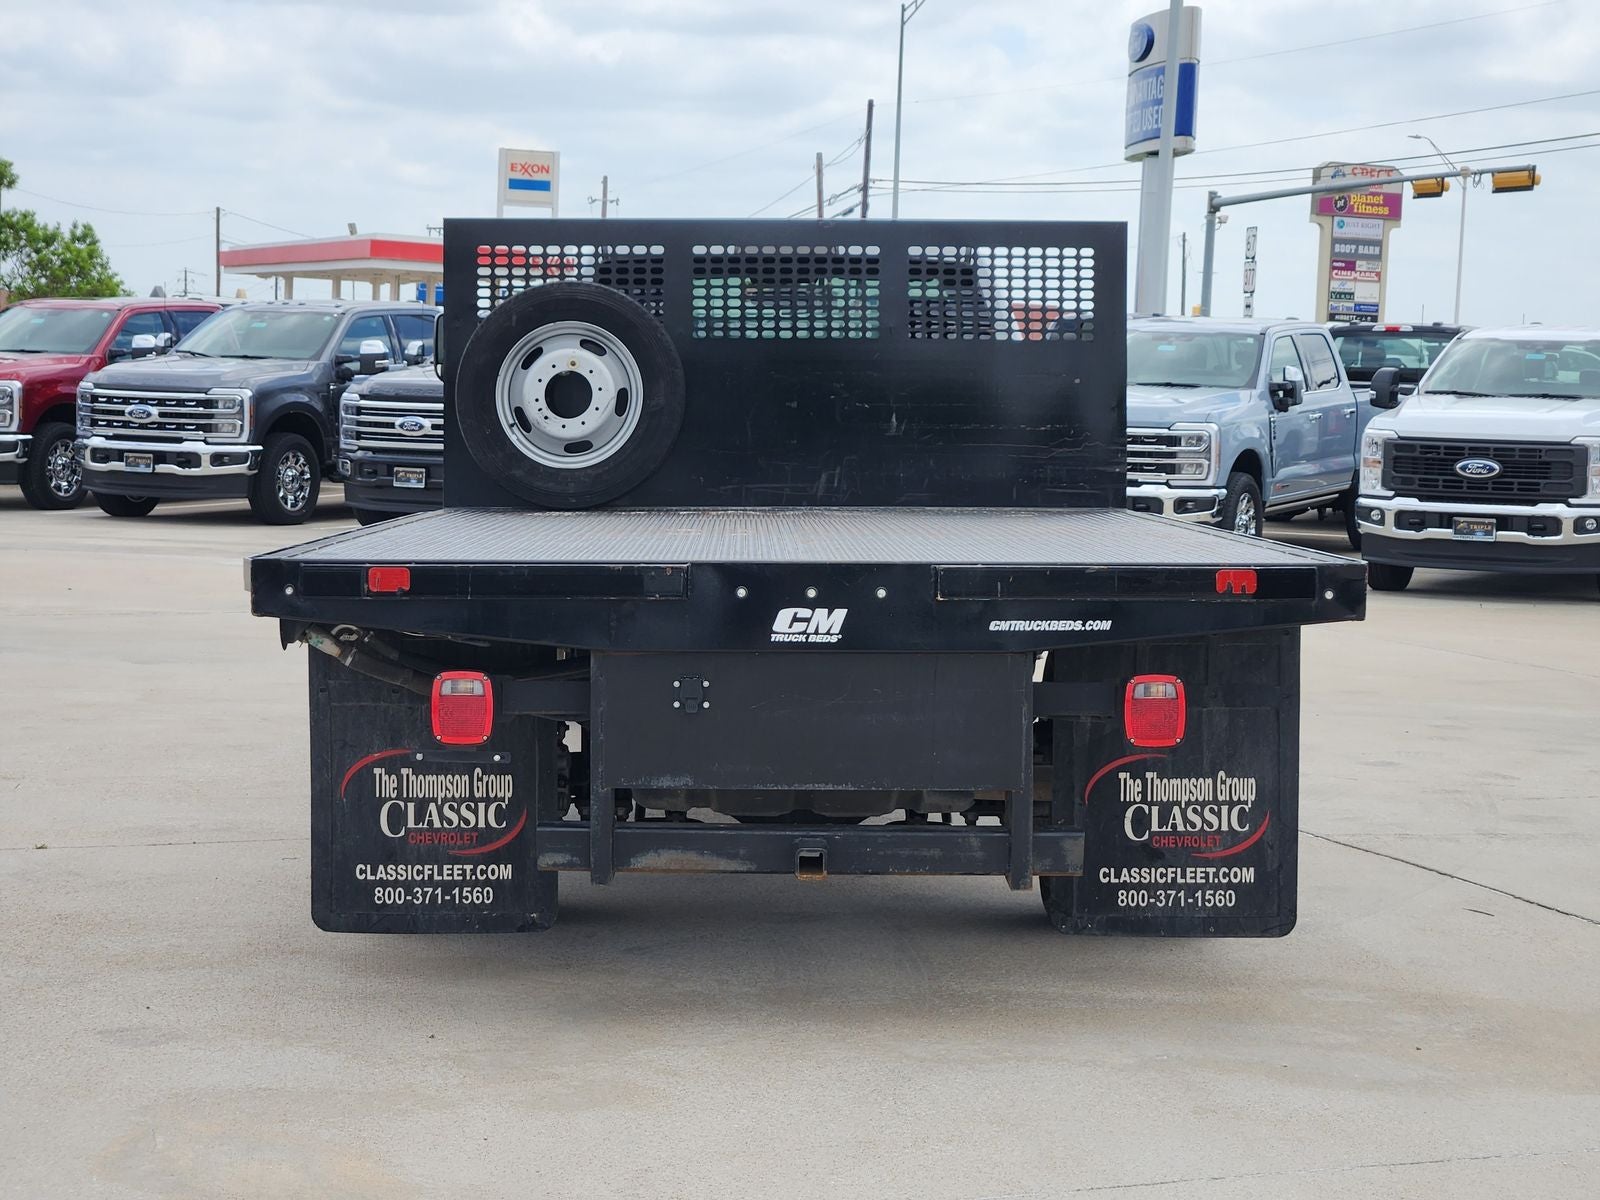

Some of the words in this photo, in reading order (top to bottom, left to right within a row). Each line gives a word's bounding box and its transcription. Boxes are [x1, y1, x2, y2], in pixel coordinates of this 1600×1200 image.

[510, 162, 550, 177] EXXON
[1350, 193, 1384, 205] planet
[1354, 203, 1389, 215] fitness
[1465, 463, 1490, 474] Ford
[772, 607, 848, 634] CM
[989, 620, 1112, 632] CMTRUCKBEDS.COM
[770, 634, 807, 642] TRUCK
[373, 767, 398, 799] The
[401, 767, 470, 804] Thompson
[473, 766, 513, 804] Group
[1118, 772, 1142, 802] The
[1145, 771, 1213, 808] Thompson
[1216, 770, 1256, 807] Group
[379, 800, 507, 838] CLASSIC
[1123, 804, 1250, 841] CLASSIC
[408, 831, 479, 845] CHEVROLET
[1152, 835, 1221, 848] CHEVROLET
[355, 863, 512, 881] CLASSICFLEET.COM
[1099, 867, 1255, 884] CLASSICFLEET.COM
[374, 887, 494, 905] 800-371-1560
[1117, 890, 1236, 907] 800-371-1560
